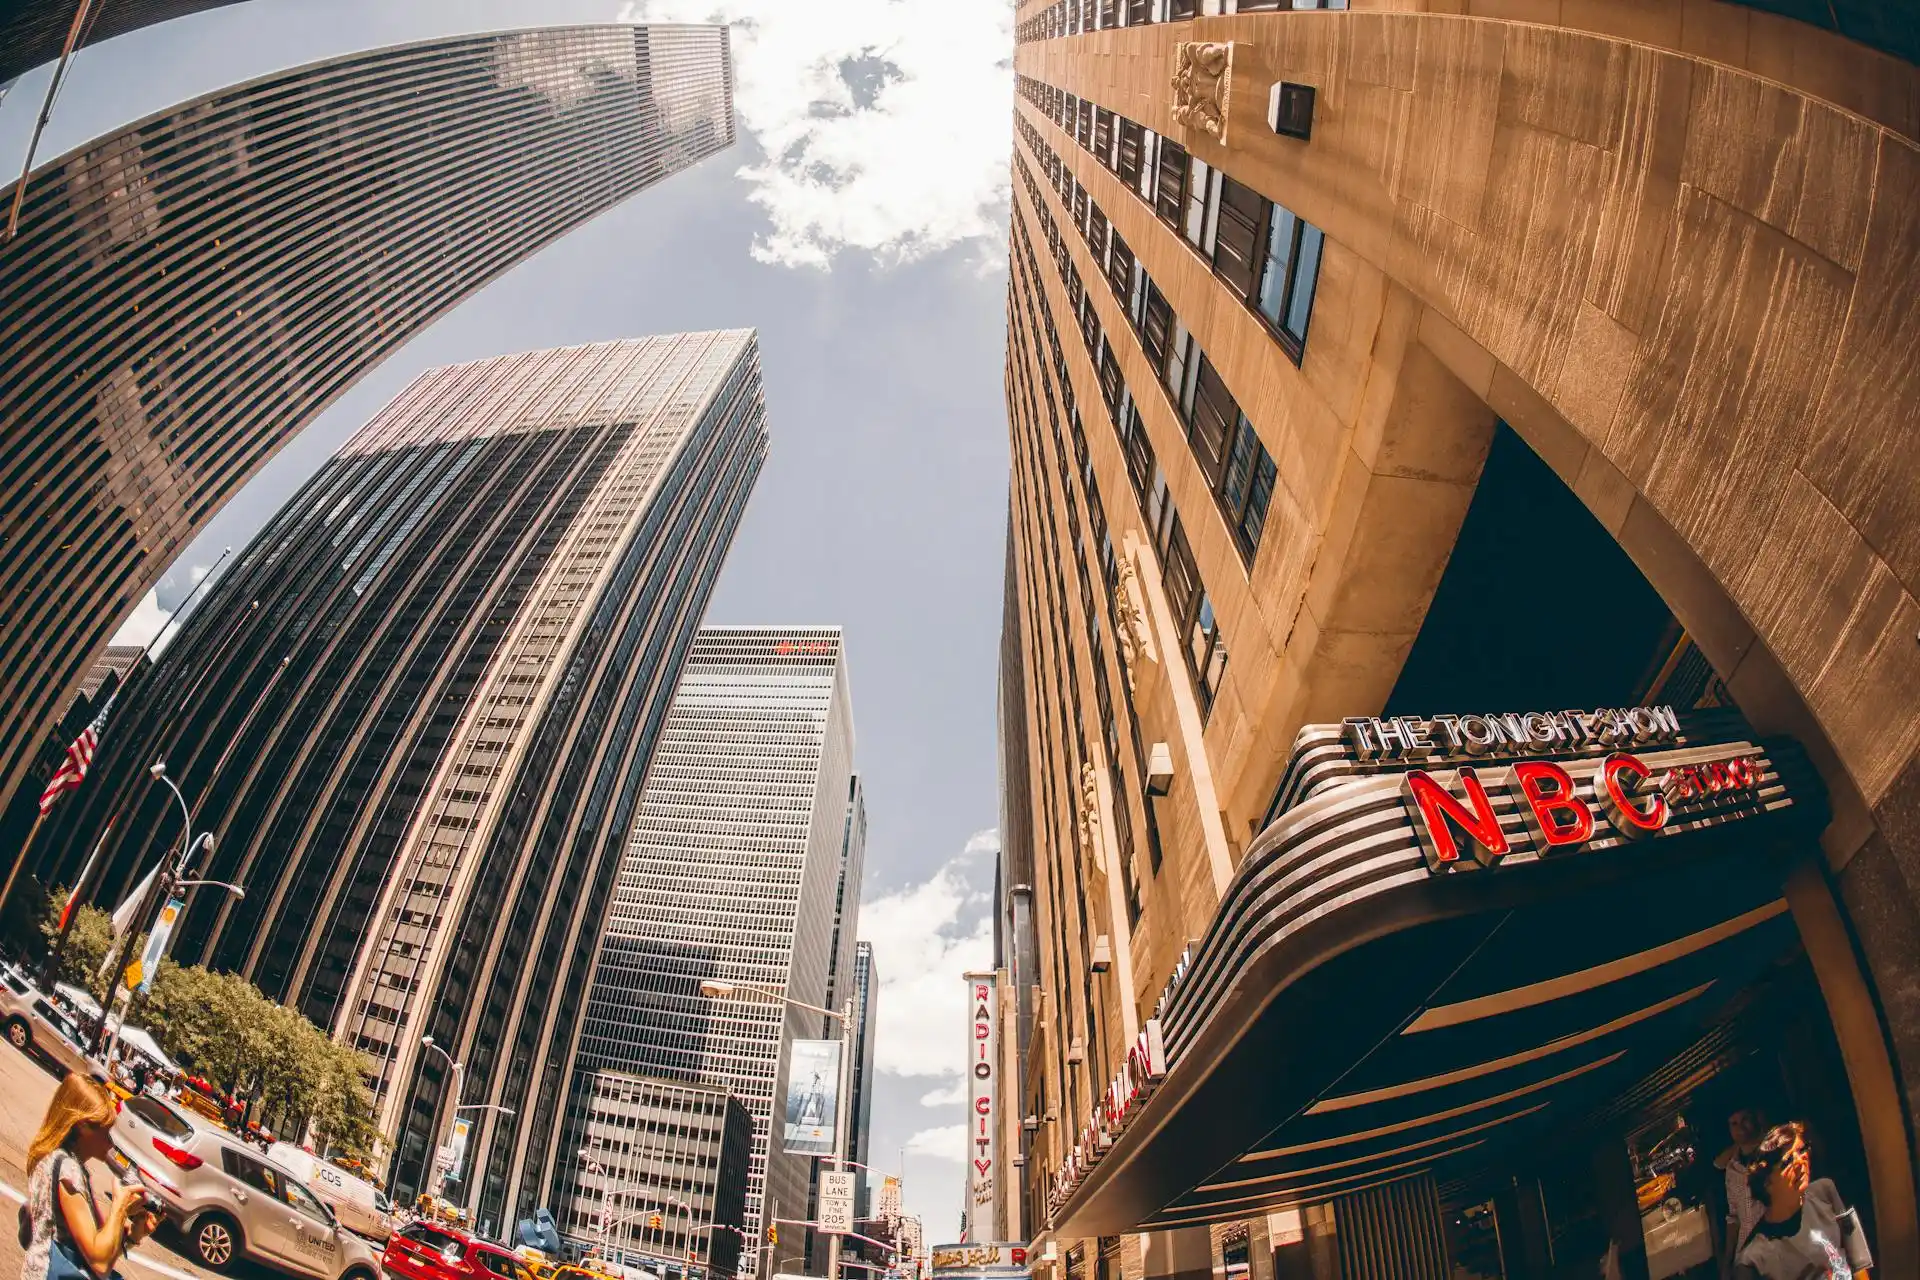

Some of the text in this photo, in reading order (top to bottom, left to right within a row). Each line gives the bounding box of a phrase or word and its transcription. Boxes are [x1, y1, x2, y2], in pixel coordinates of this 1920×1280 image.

[1343, 704, 1681, 760] THE TONIGHT SHOW
[1403, 752, 1766, 868] NBC STUDIOS
[974, 984, 992, 1177] RADIO CITY
[320, 1168, 342, 1187] CDS
[829, 1175, 847, 1185] BUS
[825, 1187, 849, 1196] LANE
[825, 1199, 840, 1207] TOW
[308, 1235, 336, 1252] UNITED
